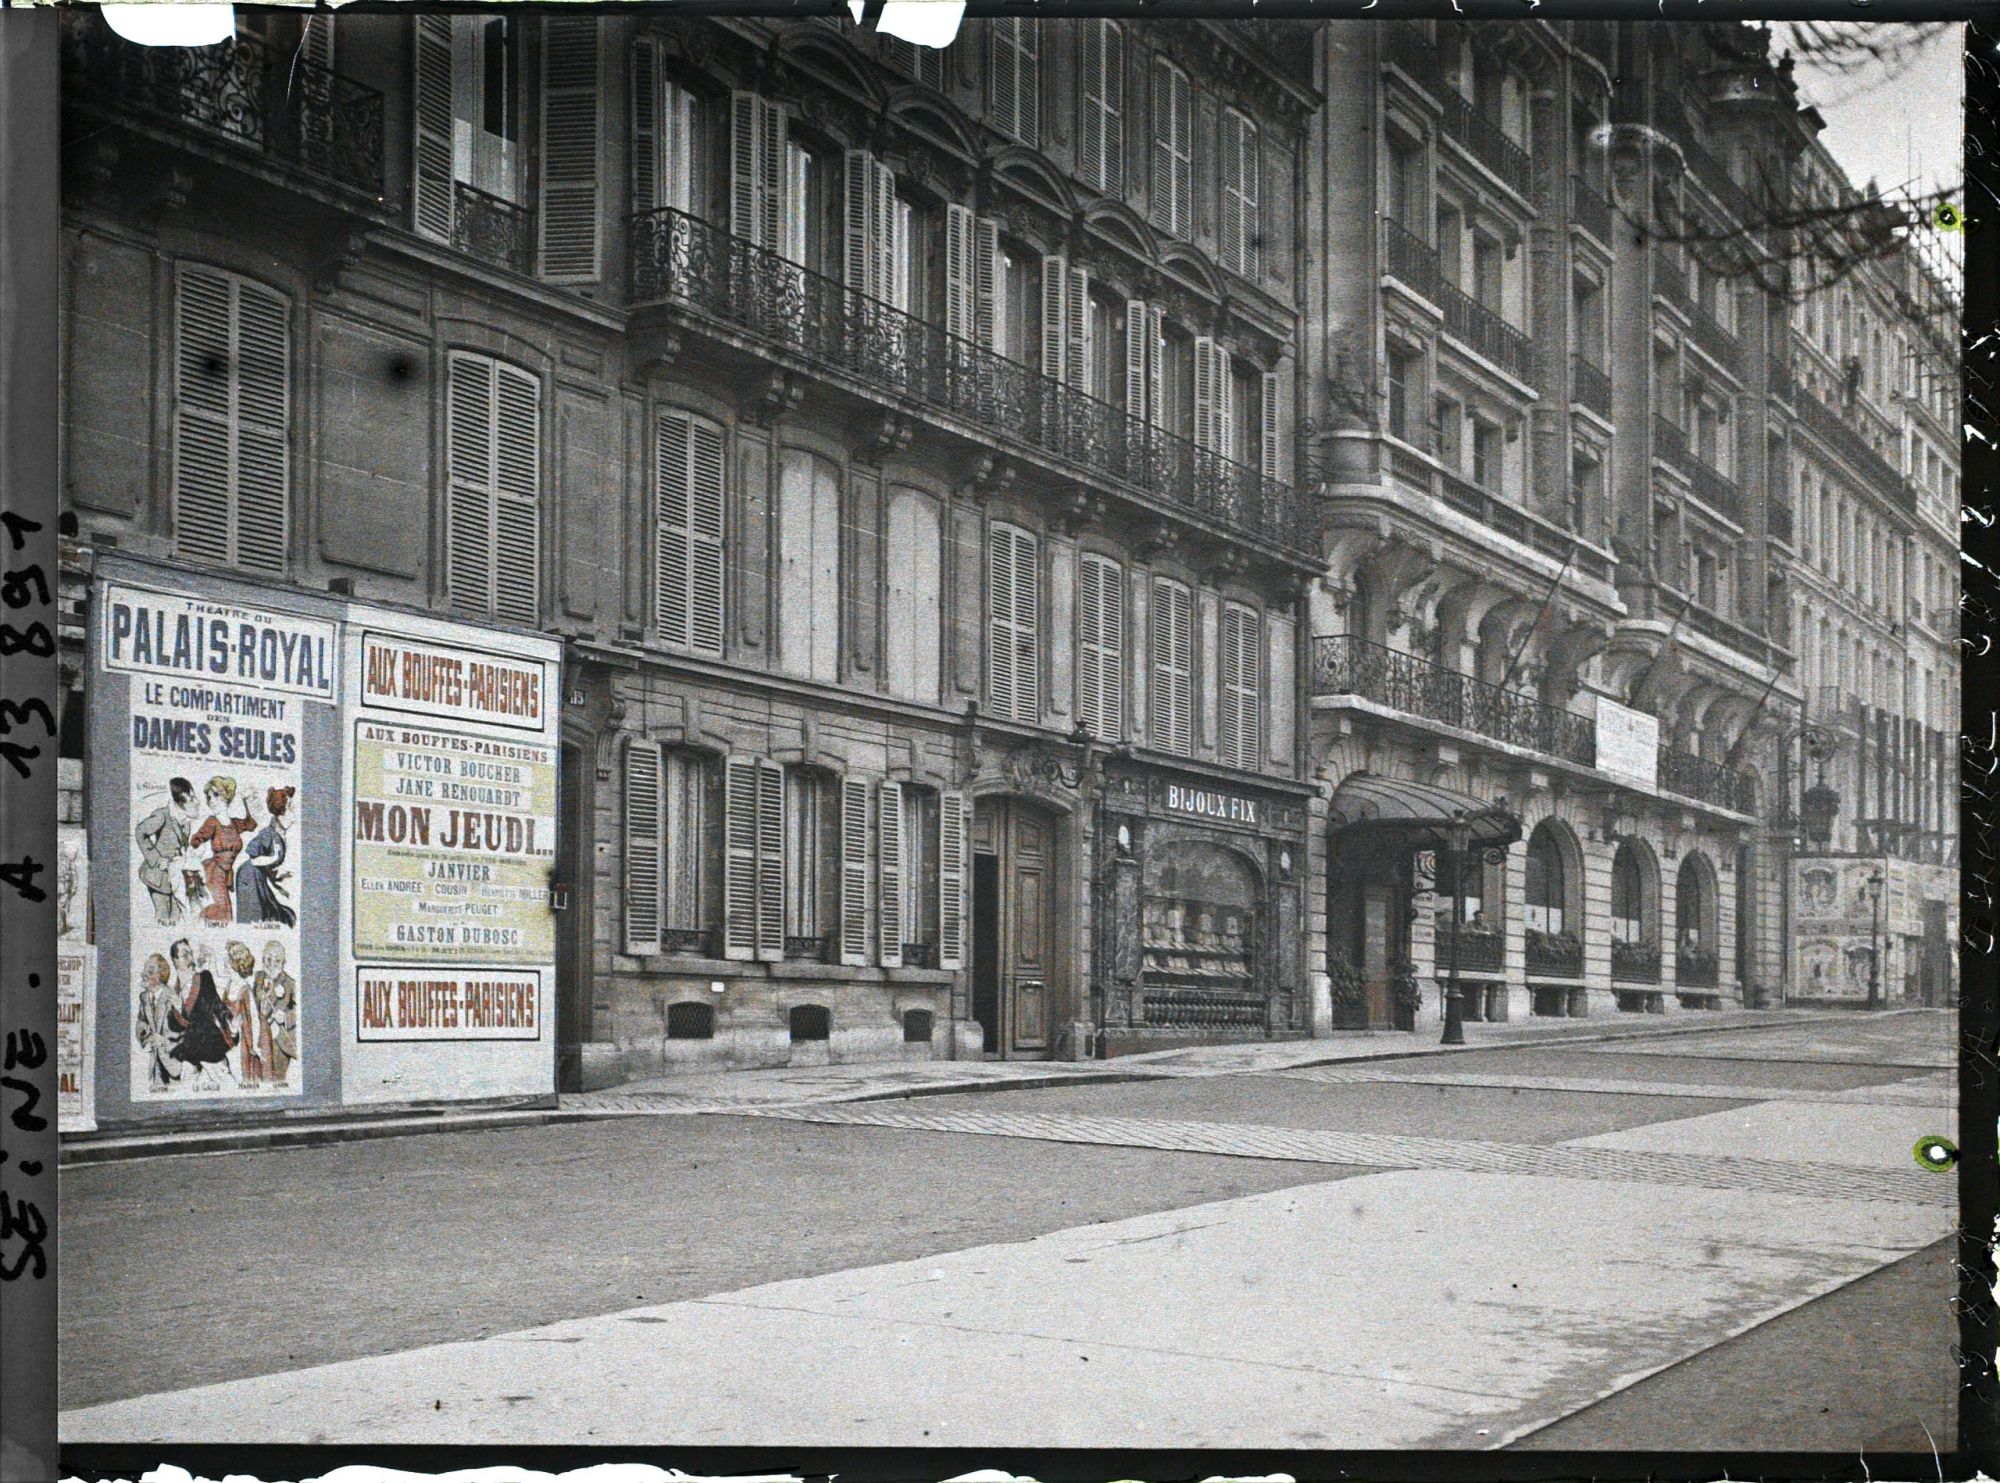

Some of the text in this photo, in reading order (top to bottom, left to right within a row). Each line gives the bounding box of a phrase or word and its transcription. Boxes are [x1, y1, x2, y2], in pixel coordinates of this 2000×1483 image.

[0, 511, 57, 658] 891
[254, 615, 272, 624] DU
[367, 645, 539, 718] AUX BOUFFES-PARISIENS
[146, 683, 286, 721] LE COMPARTIMENT
[207, 714, 230, 724] DES
[0, 698, 57, 780] 13
[134, 715, 211, 755] DAMES
[219, 726, 296, 764] SEULES
[366, 727, 548, 763] AUX BOUFFES-PARISIENS
[396, 752, 521, 783] VICTOR BOUCHER
[396, 778, 521, 807] JANE RENOUARDT
[1169, 785, 1256, 823] BIJOUX FIX
[356, 801, 431, 846] MON
[0, 856, 47, 904] A
[428, 862, 490, 881] JANVIER
[435, 883, 468, 896] COUSIN
[397, 925, 518, 945] GASTON DUBOSC
[363, 980, 535, 1028] AUX BOUFFES-PARISIENS
